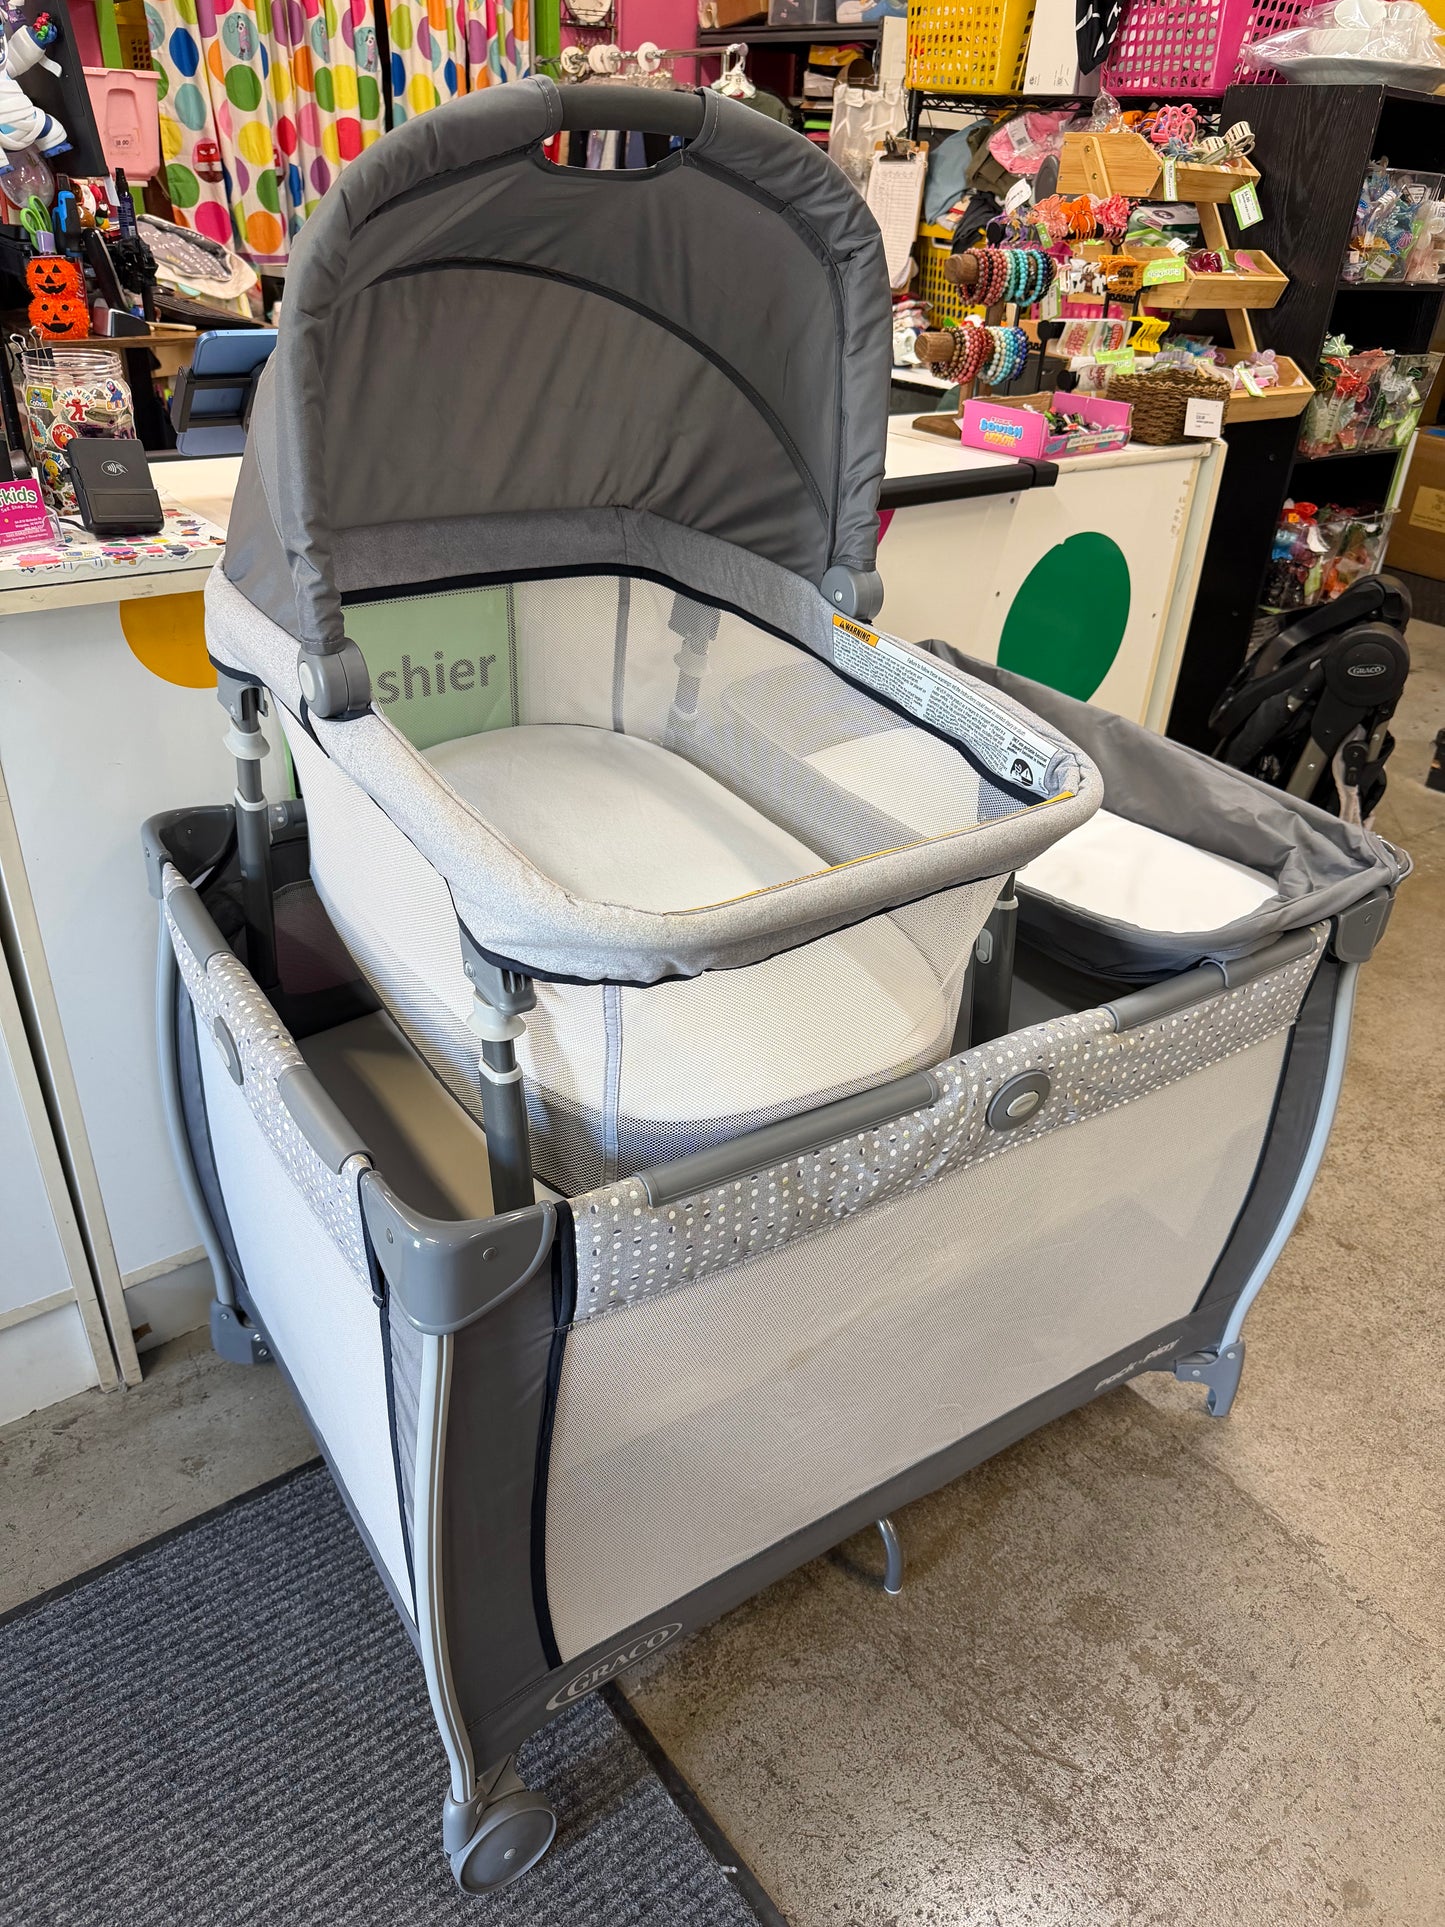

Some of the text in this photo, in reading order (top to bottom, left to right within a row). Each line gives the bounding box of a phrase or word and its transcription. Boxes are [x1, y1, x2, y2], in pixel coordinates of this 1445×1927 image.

[980, 418, 1023, 440] SQUISH
[0, 486, 38, 505] kids
[845, 622, 871, 643] WARNING
[374, 651, 496, 704] shier
[1352, 666, 1382, 674] GRACO
[566, 1630, 669, 1697] GRACO
